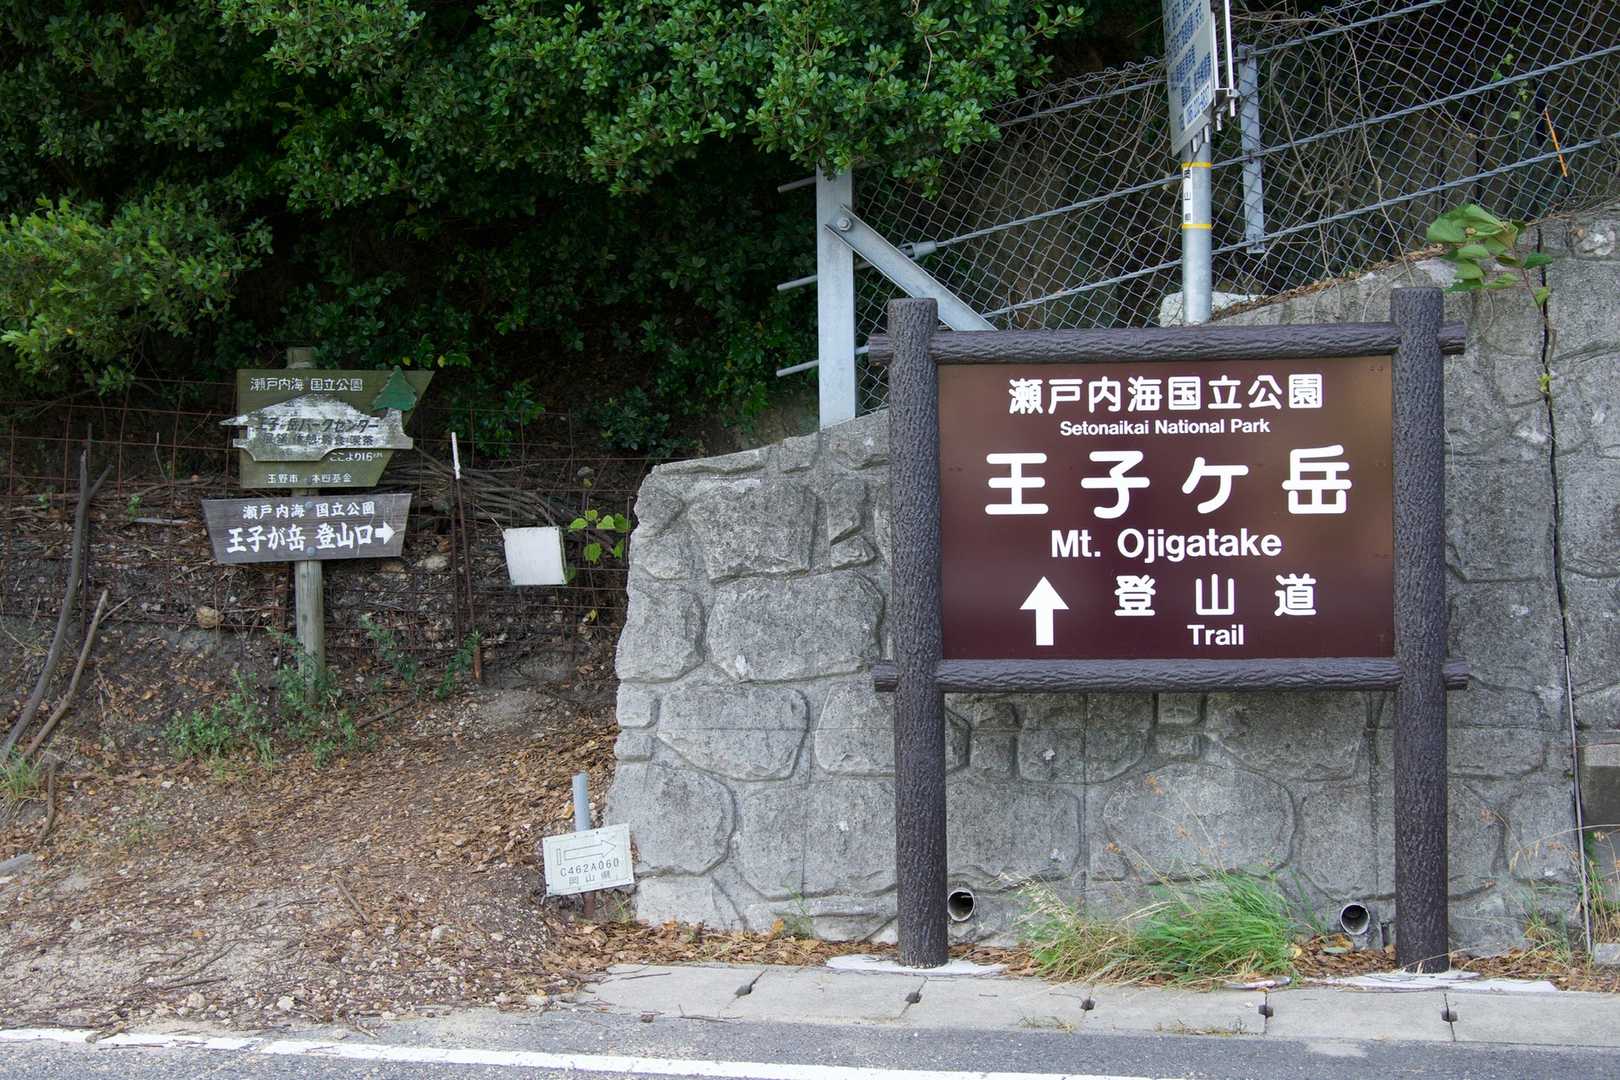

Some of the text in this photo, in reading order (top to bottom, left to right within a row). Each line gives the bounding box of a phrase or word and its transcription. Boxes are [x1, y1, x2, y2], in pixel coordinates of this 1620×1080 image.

[250, 377, 363, 391] 瀬戸内海 国立公園
[1008, 373, 1323, 414] 瀬戸内海国立公園
[1060, 418, 1271, 436] Setonaikai National Park
[242, 501, 375, 519] 瀬戸内海 国立公園
[226, 522, 373, 554] 王子が岳 登山口
[1051, 527, 1282, 564] Mt. Ojigatake
[1114, 573, 1317, 617] 登山道
[1186, 624, 1244, 646] Trail
